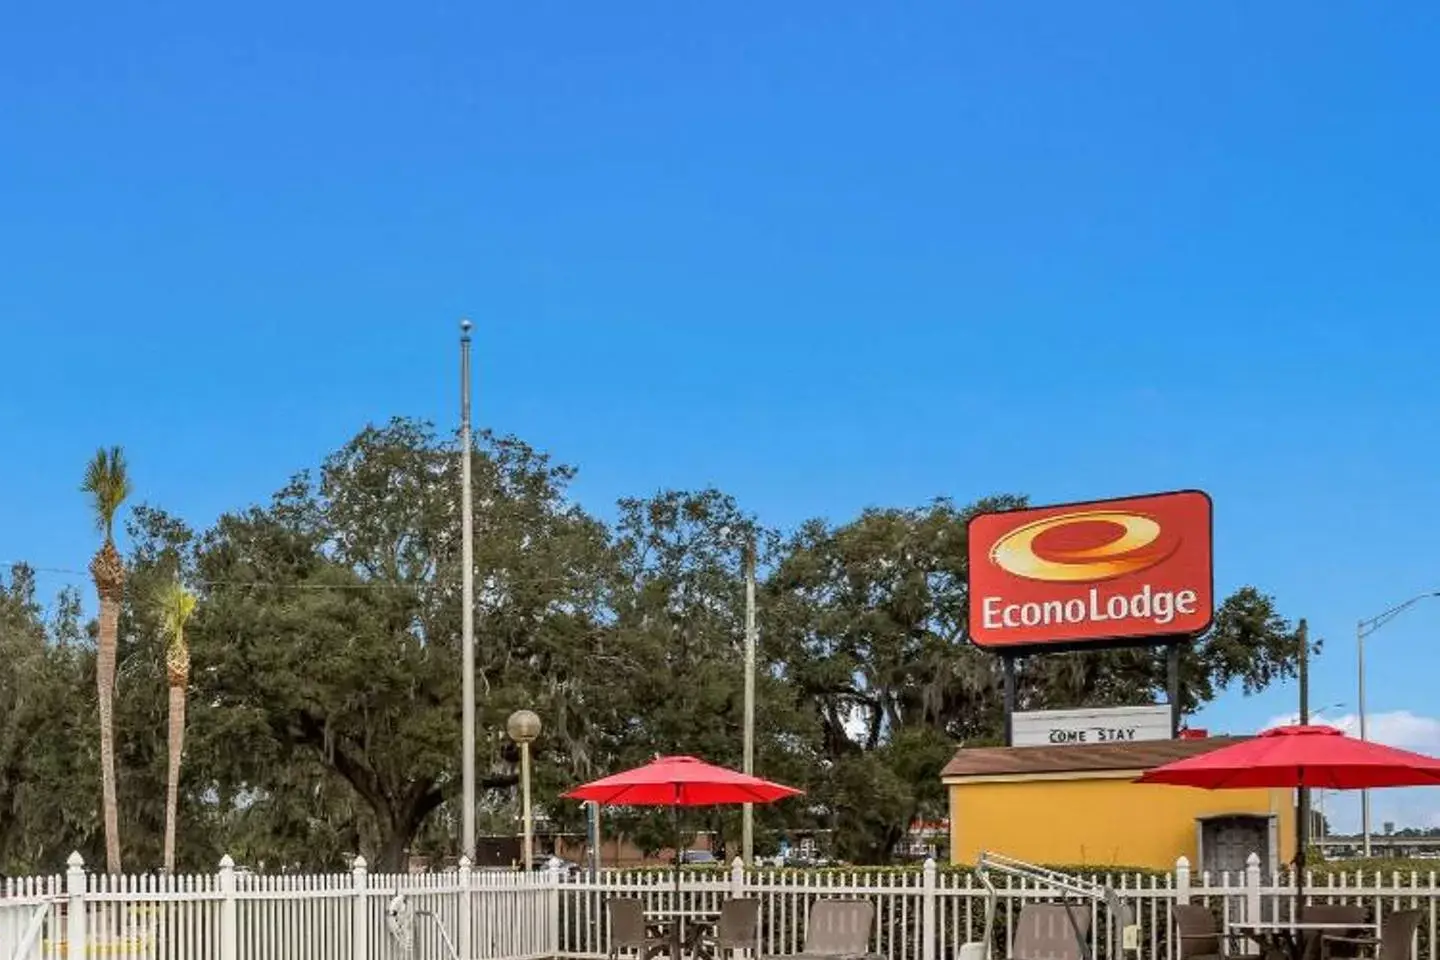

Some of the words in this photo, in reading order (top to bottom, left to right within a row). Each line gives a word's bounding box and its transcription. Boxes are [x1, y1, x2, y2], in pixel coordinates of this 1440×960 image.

[982, 585, 1198, 630] EconoLodge
[1049, 729, 1087, 744] COME
[1098, 728, 1137, 742] STAY
